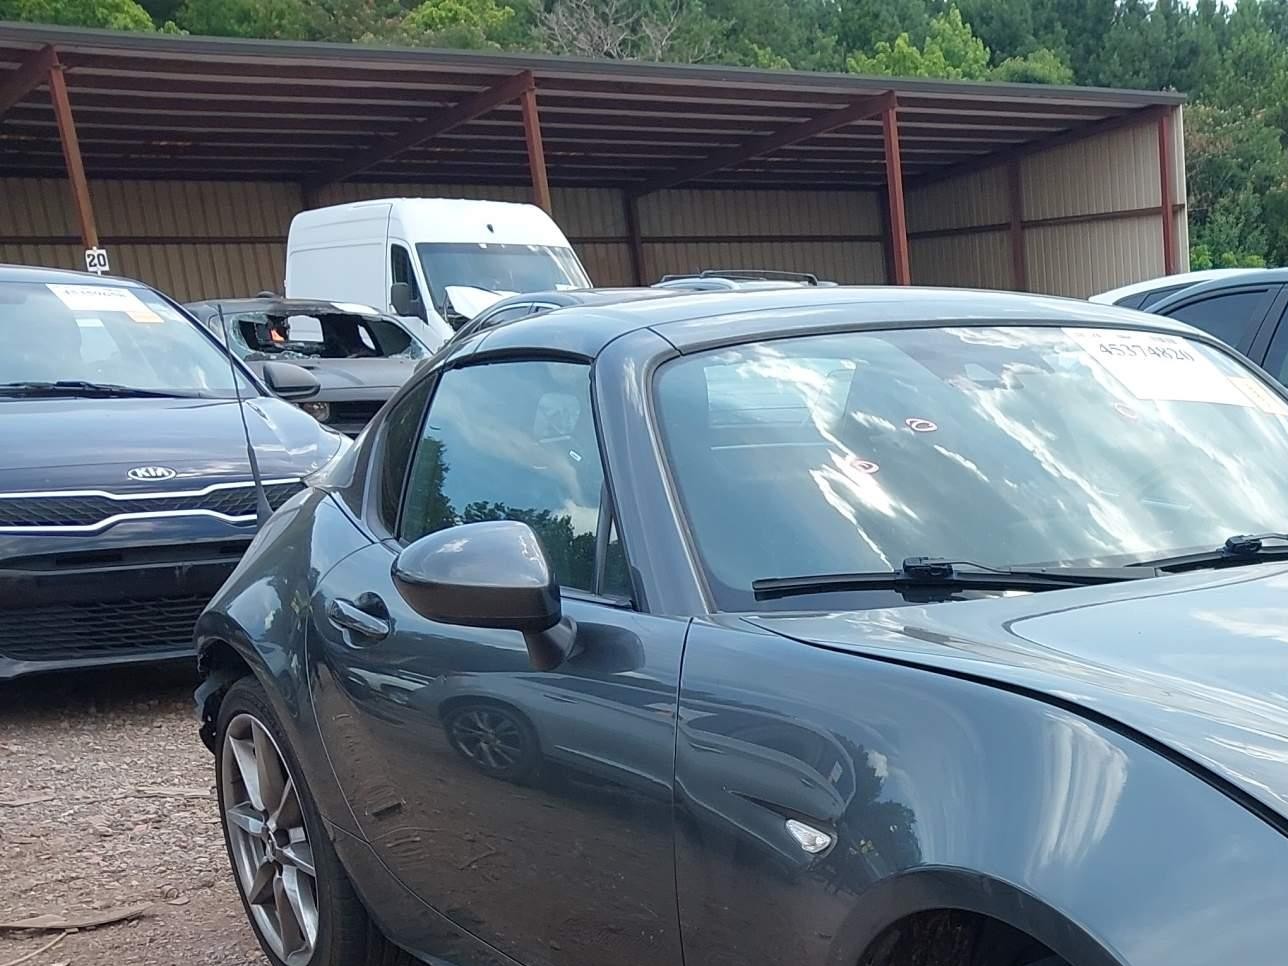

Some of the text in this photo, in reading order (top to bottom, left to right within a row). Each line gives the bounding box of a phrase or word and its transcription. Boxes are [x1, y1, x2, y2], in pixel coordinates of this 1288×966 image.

[87, 254, 107, 267] 20
[1099, 343, 1196, 362] 45374820
[133, 466, 171, 478] KIA
